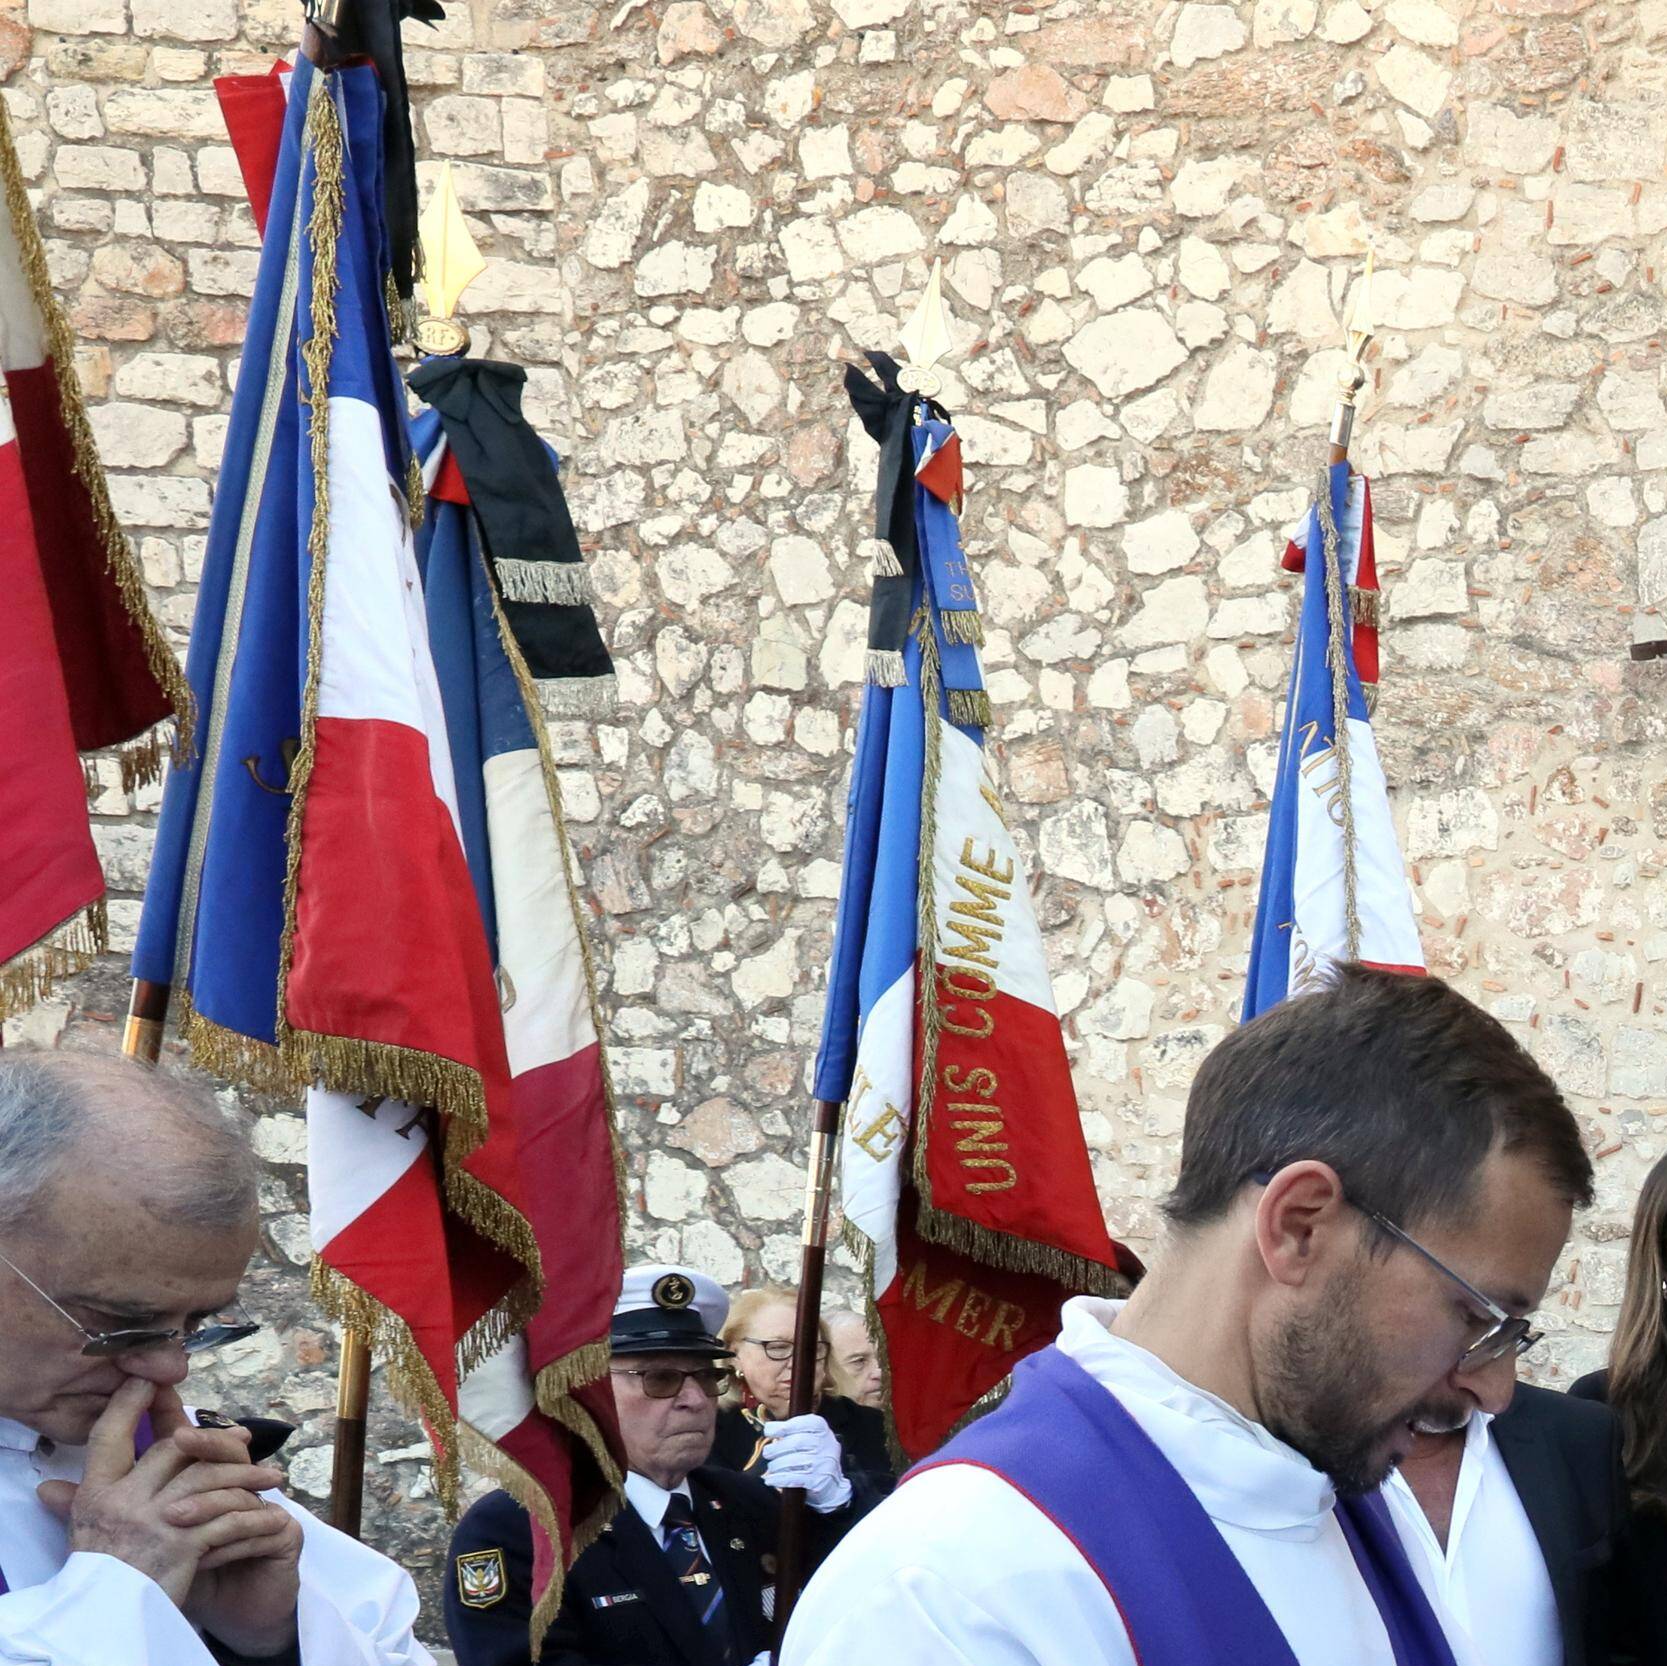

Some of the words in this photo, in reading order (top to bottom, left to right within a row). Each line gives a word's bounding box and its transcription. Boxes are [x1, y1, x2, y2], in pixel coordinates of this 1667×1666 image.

[937, 837, 1014, 1039] COMME
[943, 1065, 1017, 1195] UNIS
[902, 1260, 1026, 1352] MER
